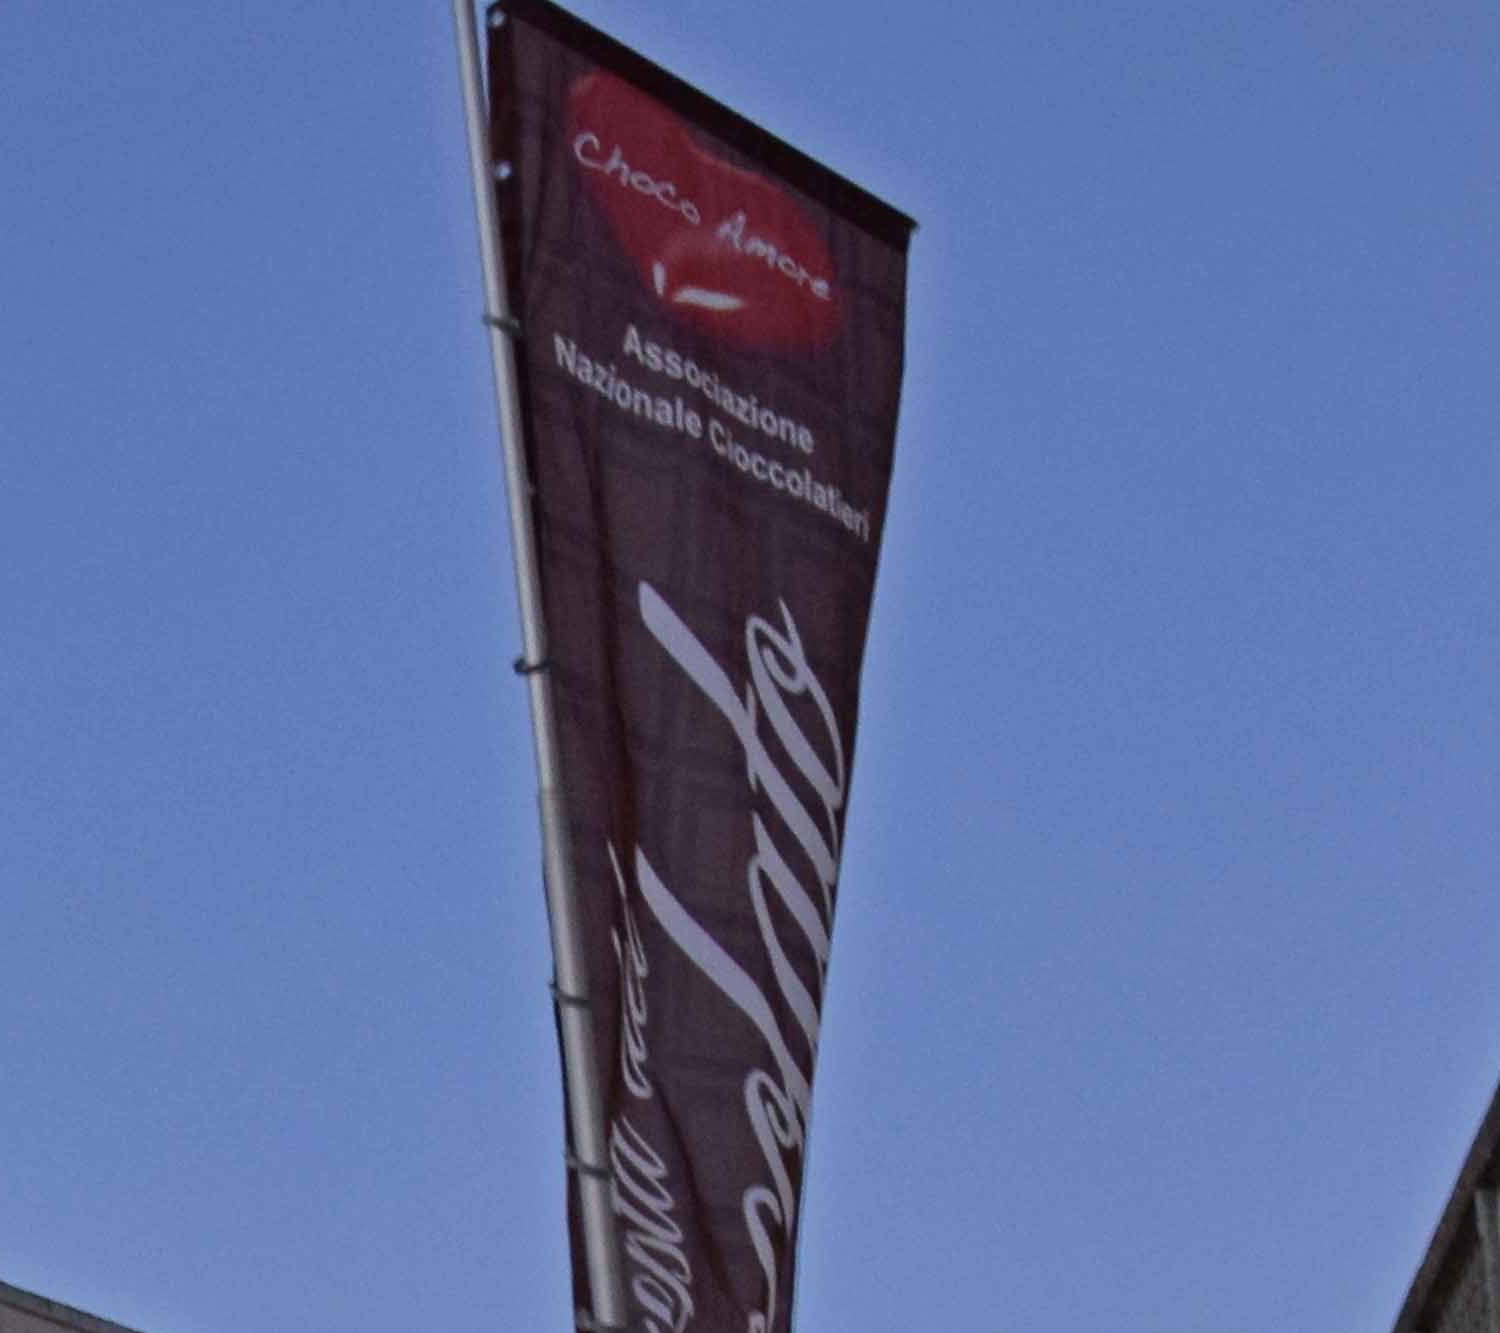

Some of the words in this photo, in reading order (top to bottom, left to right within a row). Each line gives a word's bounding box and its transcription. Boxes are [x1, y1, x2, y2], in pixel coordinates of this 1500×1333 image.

[573, 131, 700, 225] Choco
[714, 211, 830, 301] Amore
[553, 332, 703, 438] Nazionale
[623, 323, 814, 454] Associazione
